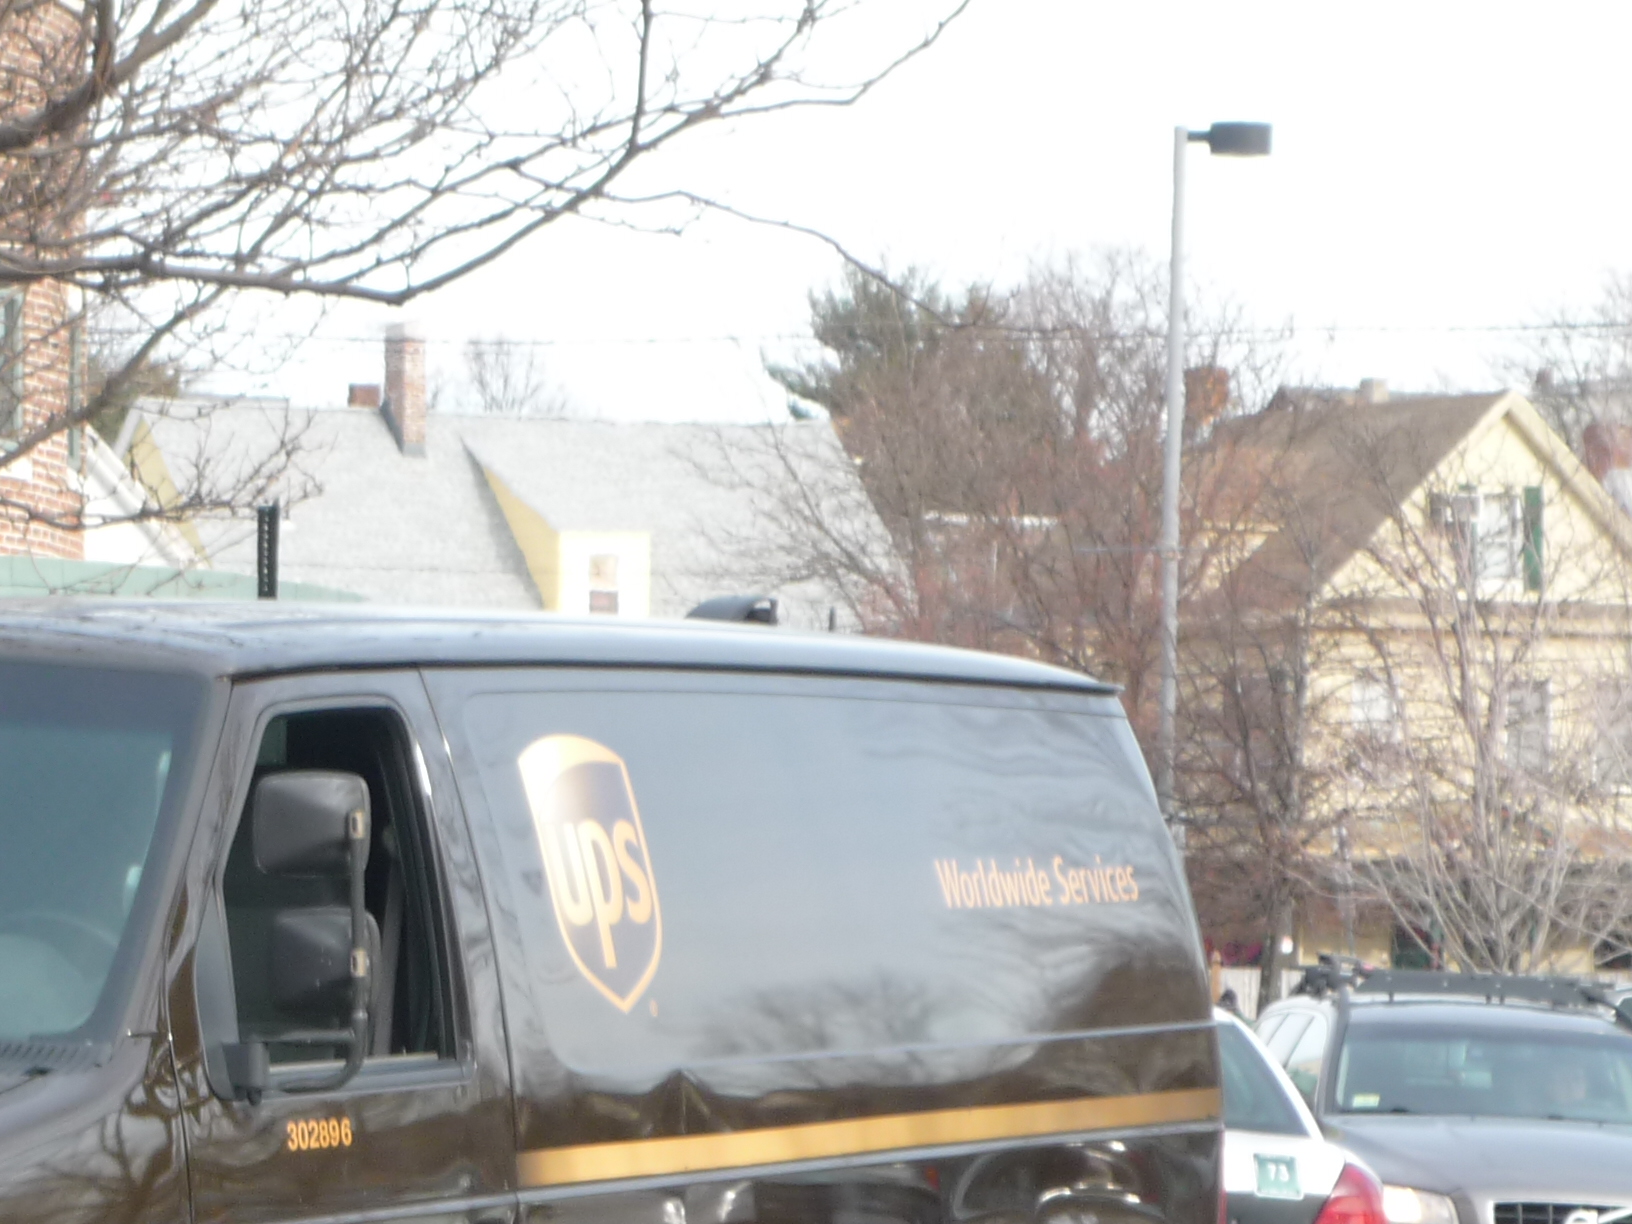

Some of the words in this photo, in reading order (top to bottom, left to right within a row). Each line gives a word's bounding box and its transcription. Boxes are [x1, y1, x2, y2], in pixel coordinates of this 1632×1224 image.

[934, 858, 1052, 909] Worldwide
[1053, 854, 1140, 905] Services
[287, 1116, 353, 1152] 302896
